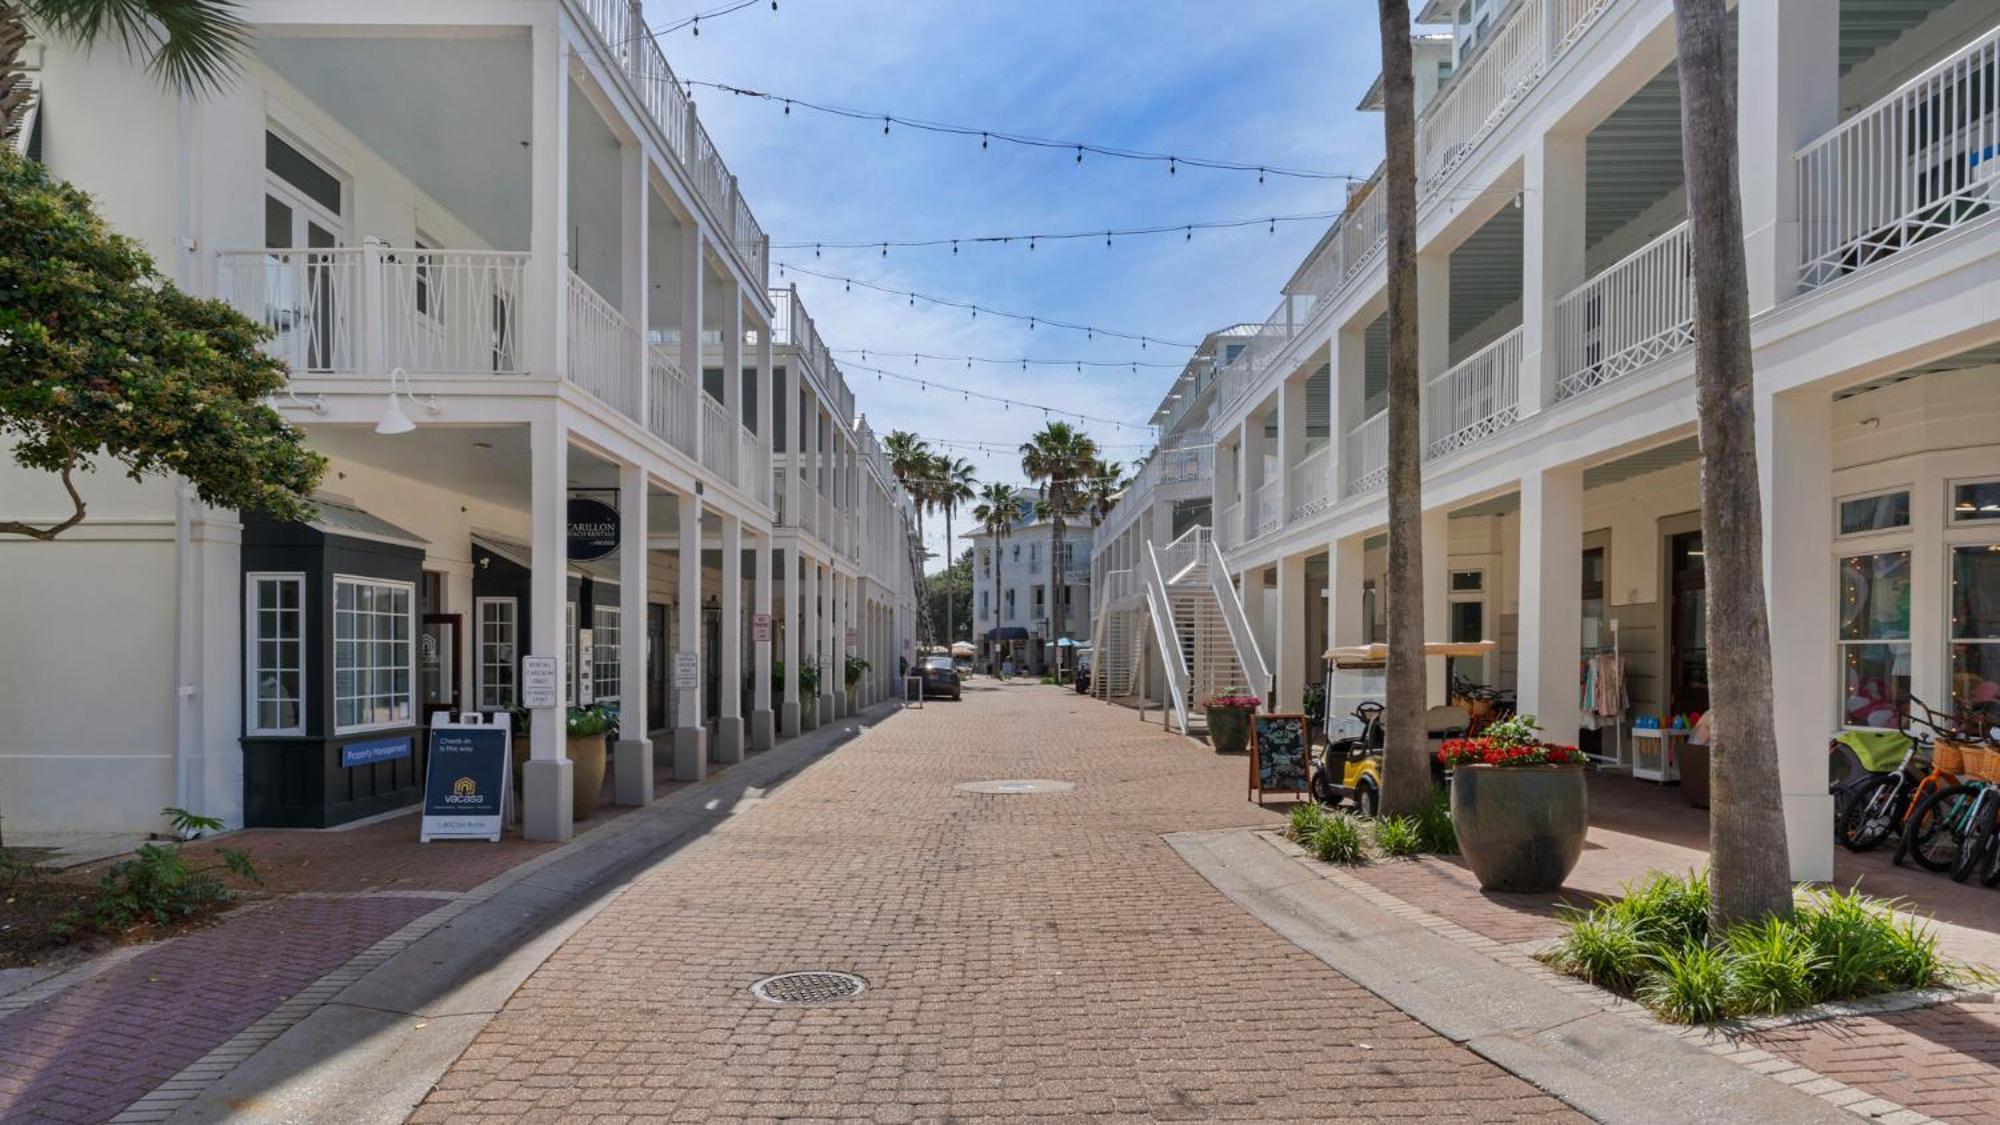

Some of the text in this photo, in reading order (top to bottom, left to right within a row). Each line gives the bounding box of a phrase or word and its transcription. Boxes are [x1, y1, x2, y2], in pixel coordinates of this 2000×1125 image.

[347, 745, 407, 760] Property Management
[445, 794, 484, 803] vacasa
